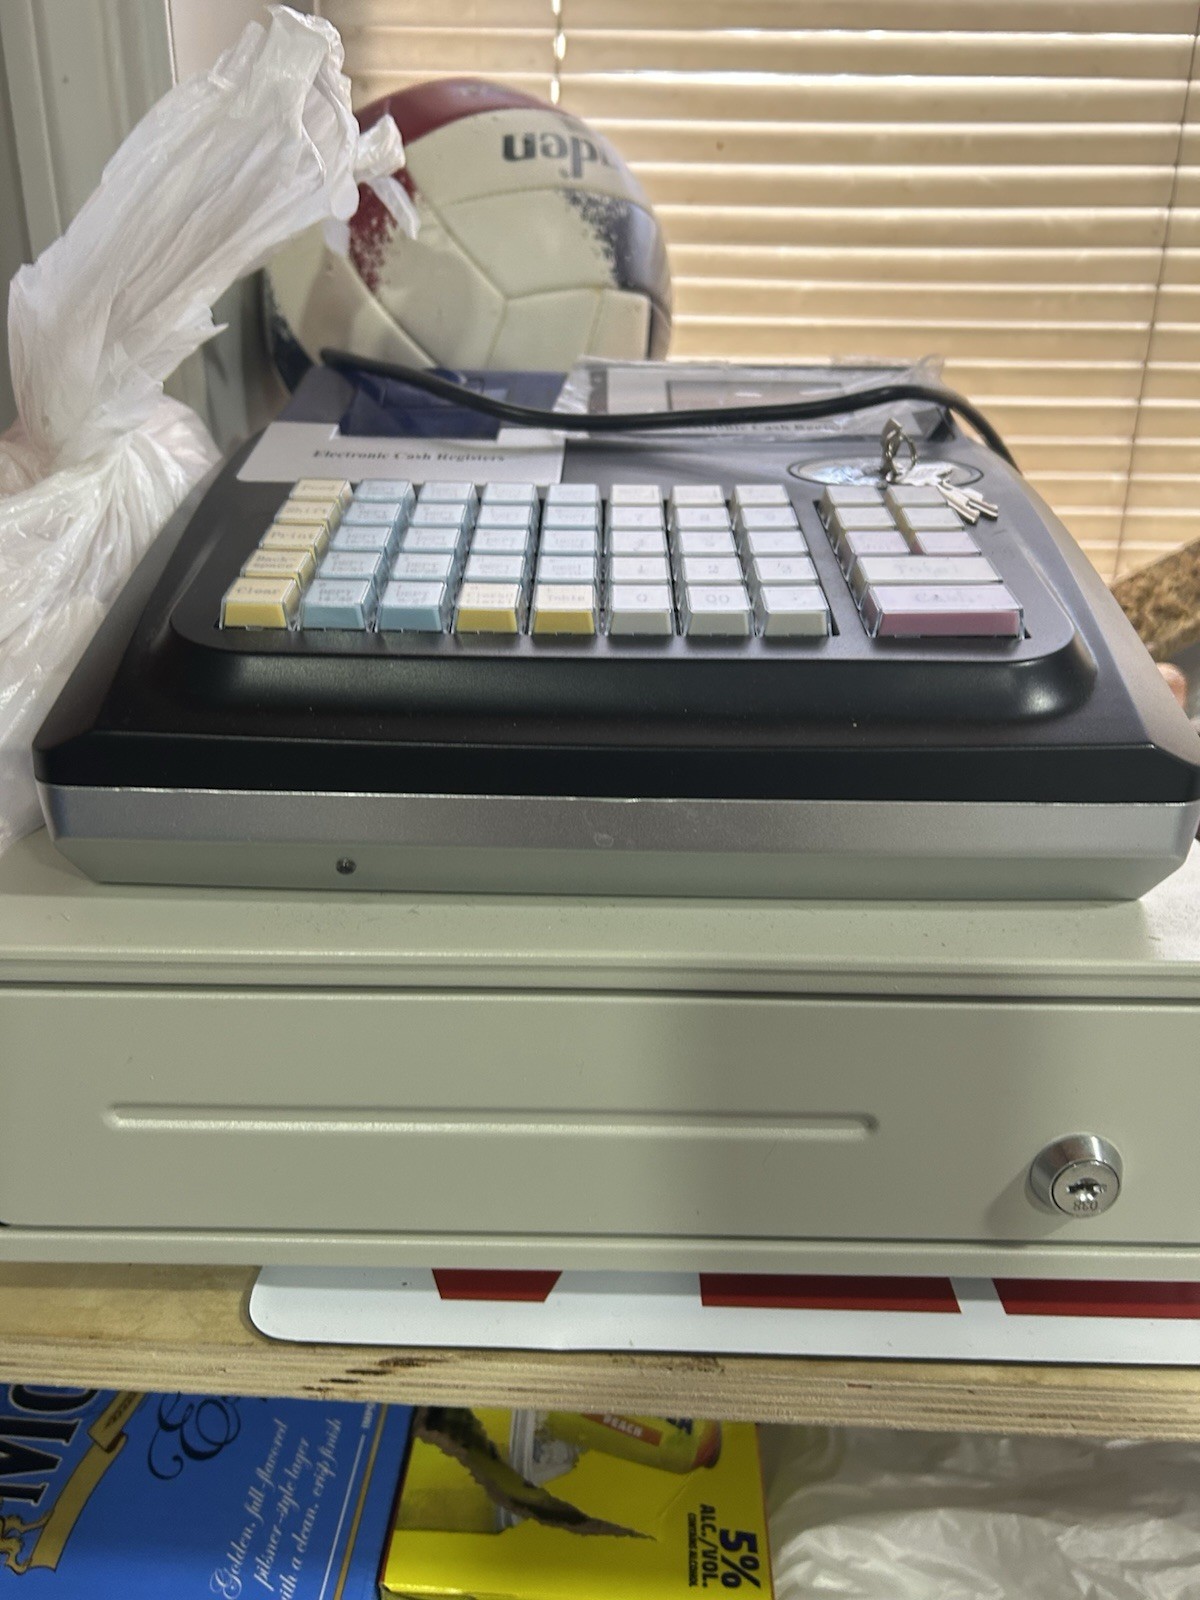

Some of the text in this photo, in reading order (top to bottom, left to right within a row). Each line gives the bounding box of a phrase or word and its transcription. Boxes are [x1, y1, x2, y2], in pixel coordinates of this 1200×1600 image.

[313, 449, 506, 463] Electronic Cash Registers
[237, 586, 279, 595] Clear
[318, 1418, 342, 1466] finish
[313, 1460, 336, 1497] crisp
[209, 1417, 288, 1600] Golden, full-flavored
[253, 1437, 313, 1592] pilsner-style lager
[292, 1556, 302, 1571] a
[698, 1503, 718, 1588] ALC./VOL.
[720, 1528, 761, 1589] 5%
